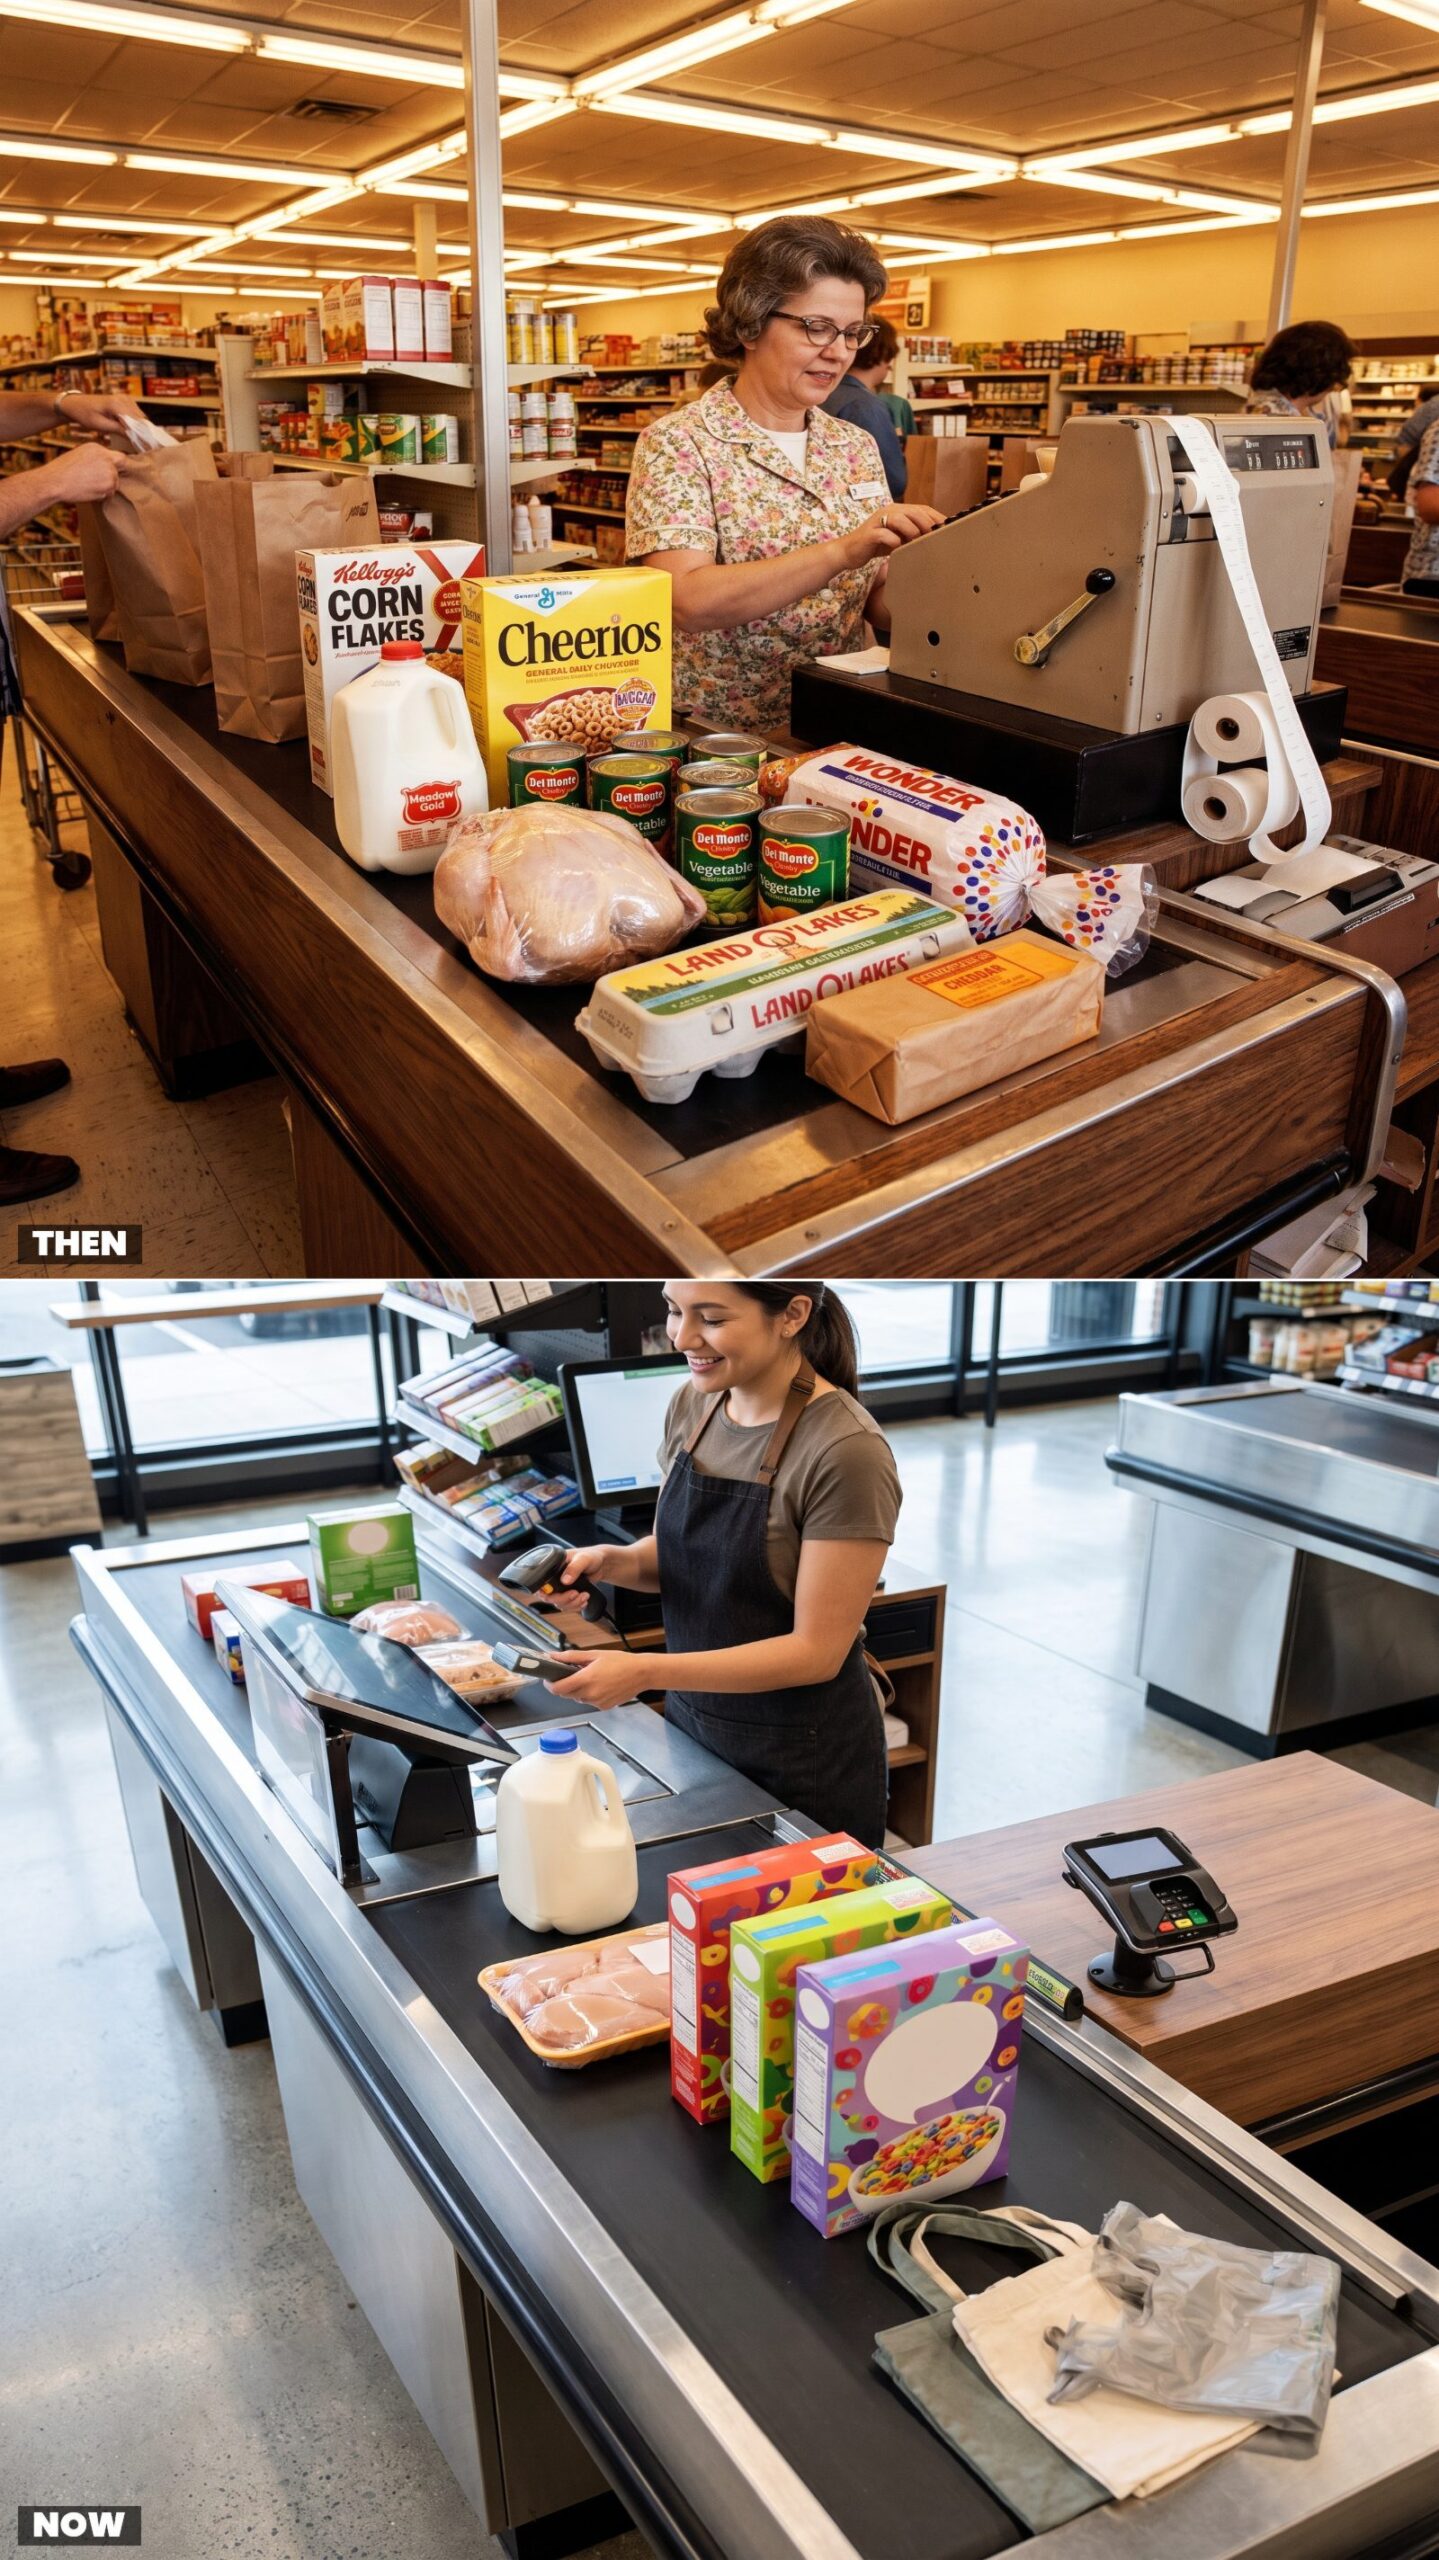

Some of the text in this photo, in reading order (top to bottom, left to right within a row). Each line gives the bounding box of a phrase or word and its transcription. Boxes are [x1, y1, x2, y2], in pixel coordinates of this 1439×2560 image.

[333, 560, 416, 586] Kellogg's
[328, 584, 424, 622] CORN
[332, 618, 425, 649] FLAKES
[498, 612, 662, 667] Cheerios
[526, 668, 568, 678] GENERAL
[570, 665, 593, 673] DAILY
[547, 776, 577, 788] Monte
[843, 755, 985, 811] WONDER
[409, 791, 453, 803] Meadow
[420, 801, 445, 812] Gold
[615, 790, 663, 803] Del Monte
[697, 832, 750, 845] Del Monte
[850, 816, 932, 876] NDER
[764, 846, 815, 865] Del Monte
[689, 860, 753, 878] Vegetable
[760, 873, 821, 897] Vegetable
[665, 943, 754, 976] LAND
[752, 903, 880, 948] O'LAKES
[944, 964, 1007, 990] CHEDDAR
[750, 988, 813, 1029] LAND
